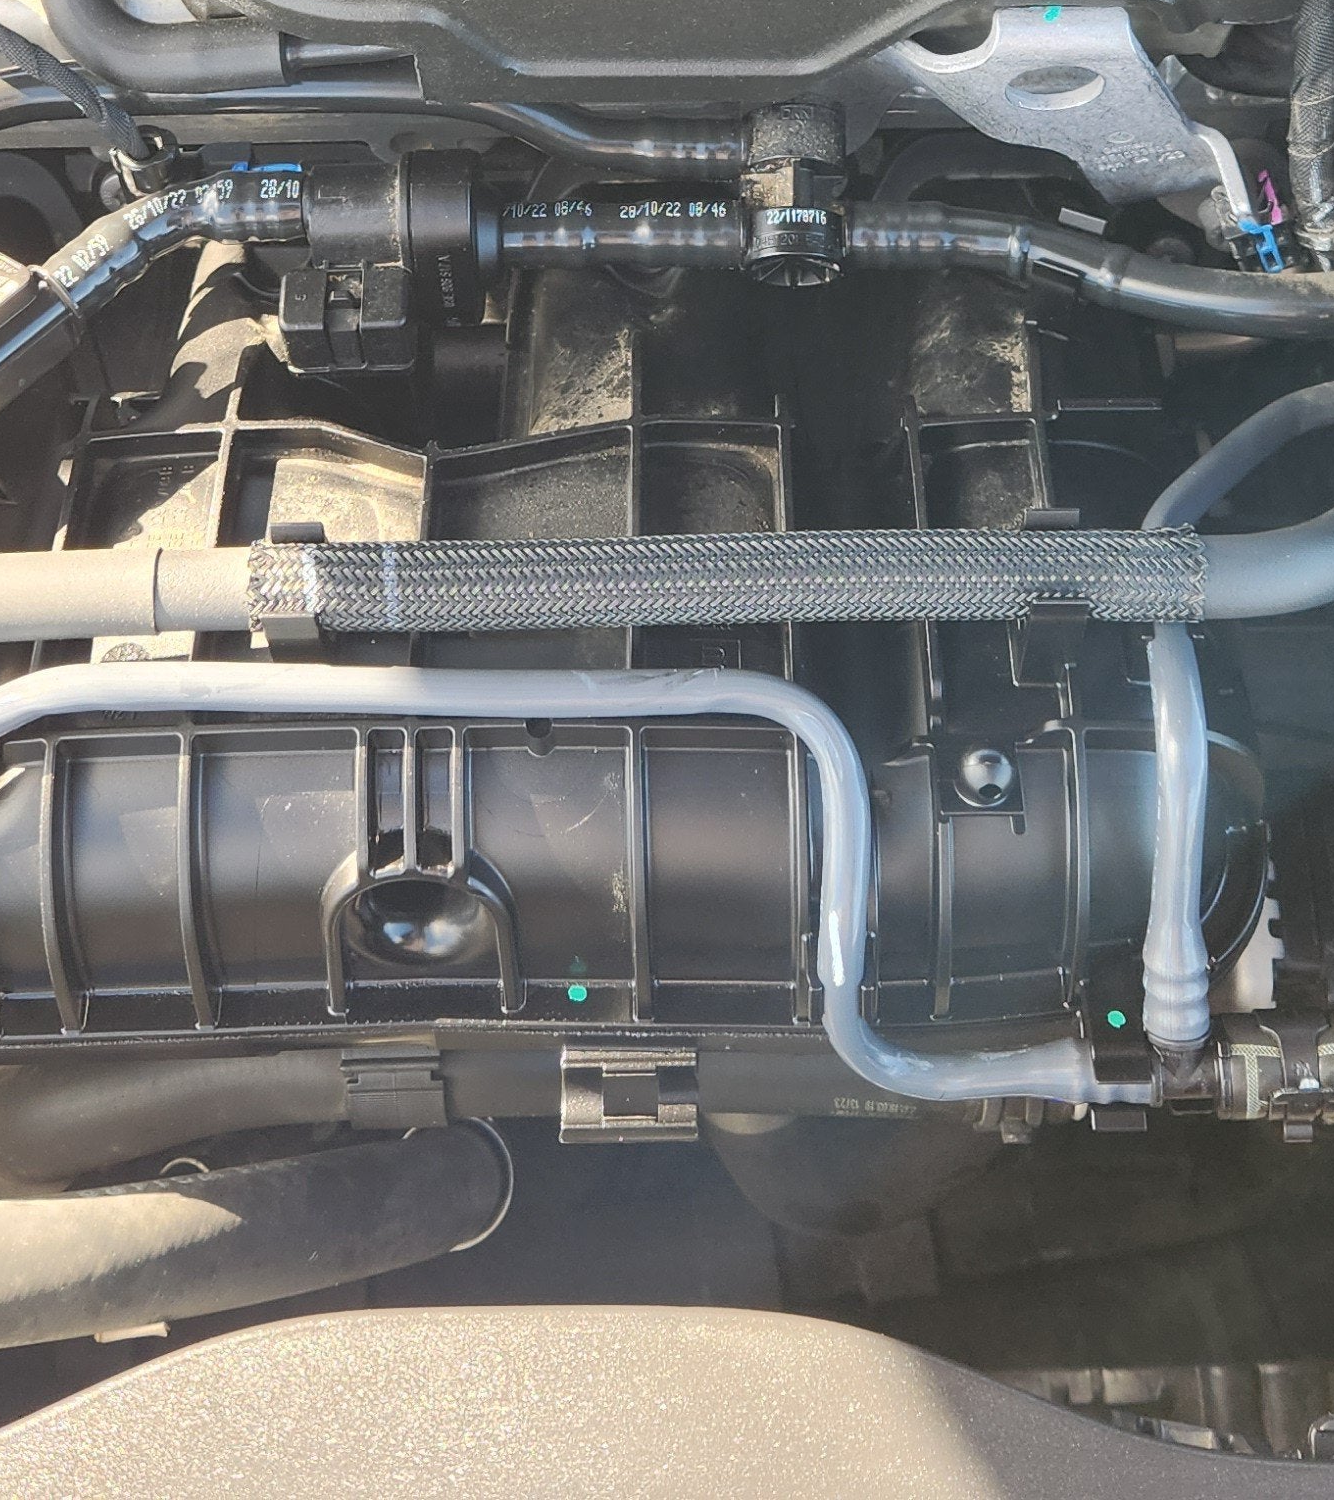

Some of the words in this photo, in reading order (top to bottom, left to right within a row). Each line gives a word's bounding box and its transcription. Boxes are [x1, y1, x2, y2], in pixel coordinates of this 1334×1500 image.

[260, 178, 300, 199] 28/10
[619, 200, 682, 219] 28/10/22
[688, 201, 727, 219] 08/46
[766, 208, 828, 226] 22/1178716
